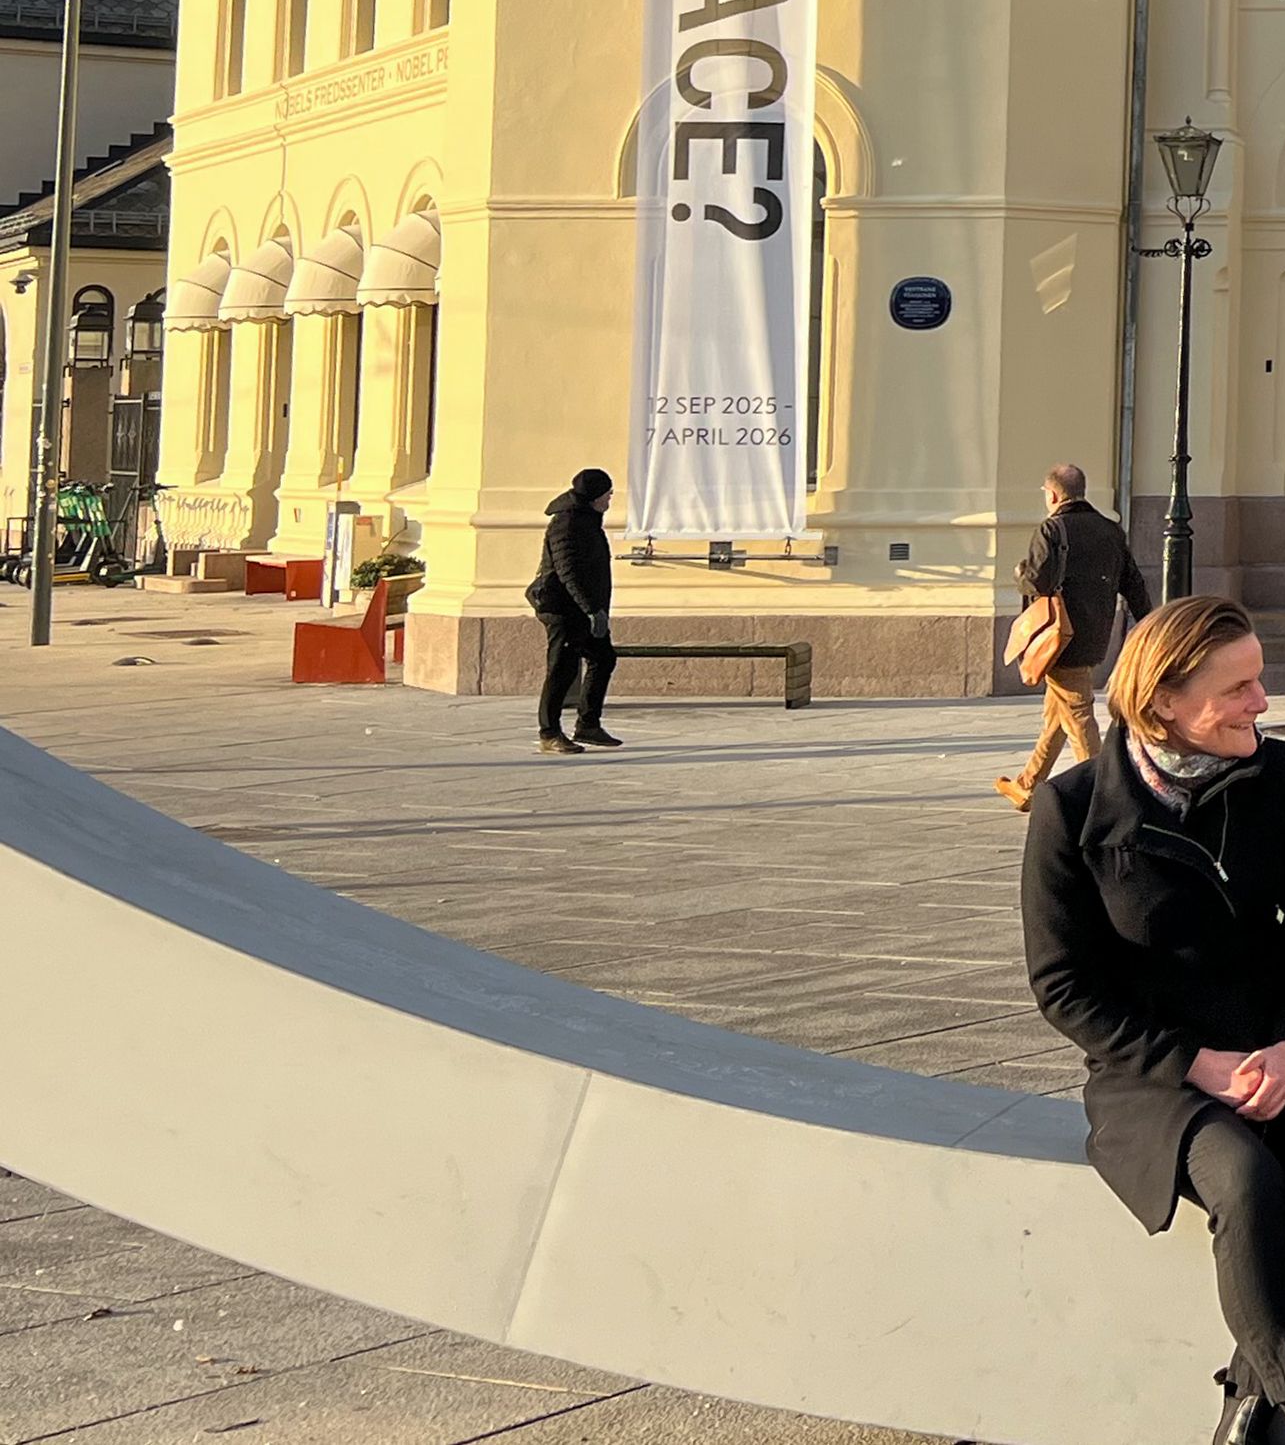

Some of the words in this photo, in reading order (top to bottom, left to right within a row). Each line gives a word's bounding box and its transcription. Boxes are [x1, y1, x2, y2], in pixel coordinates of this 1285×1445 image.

[396, 51, 434, 83] NOBEL
[647, 397, 668, 414] 12
[675, 397, 716, 414] SEP
[722, 397, 777, 414] 2025
[646, 428, 656, 446] 7
[661, 428, 730, 446] APRIL
[735, 428, 792, 446] 2026
